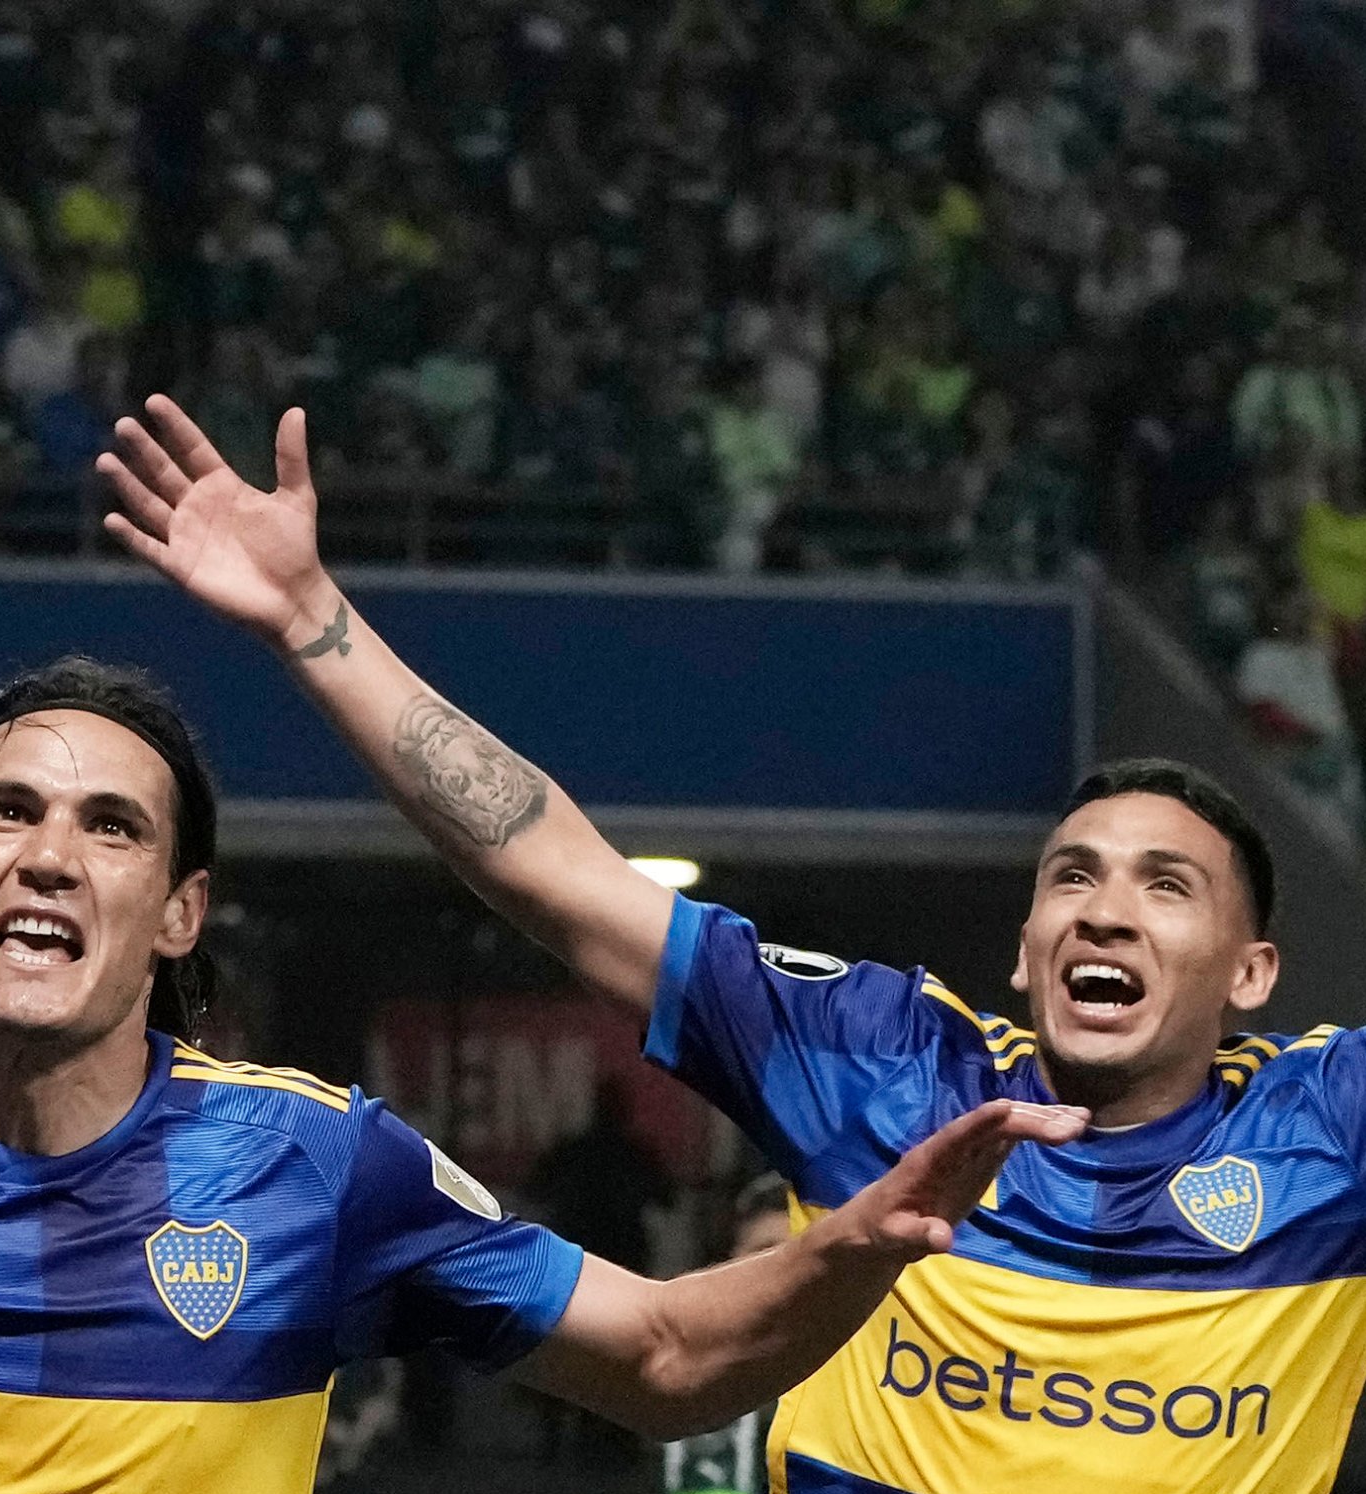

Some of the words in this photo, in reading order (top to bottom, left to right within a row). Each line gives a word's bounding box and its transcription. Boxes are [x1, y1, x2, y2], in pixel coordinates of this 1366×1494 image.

[1189, 1185, 1253, 1215] CABJ
[162, 1261, 235, 1284] CABJ
[879, 1316, 1273, 1439] betsson
